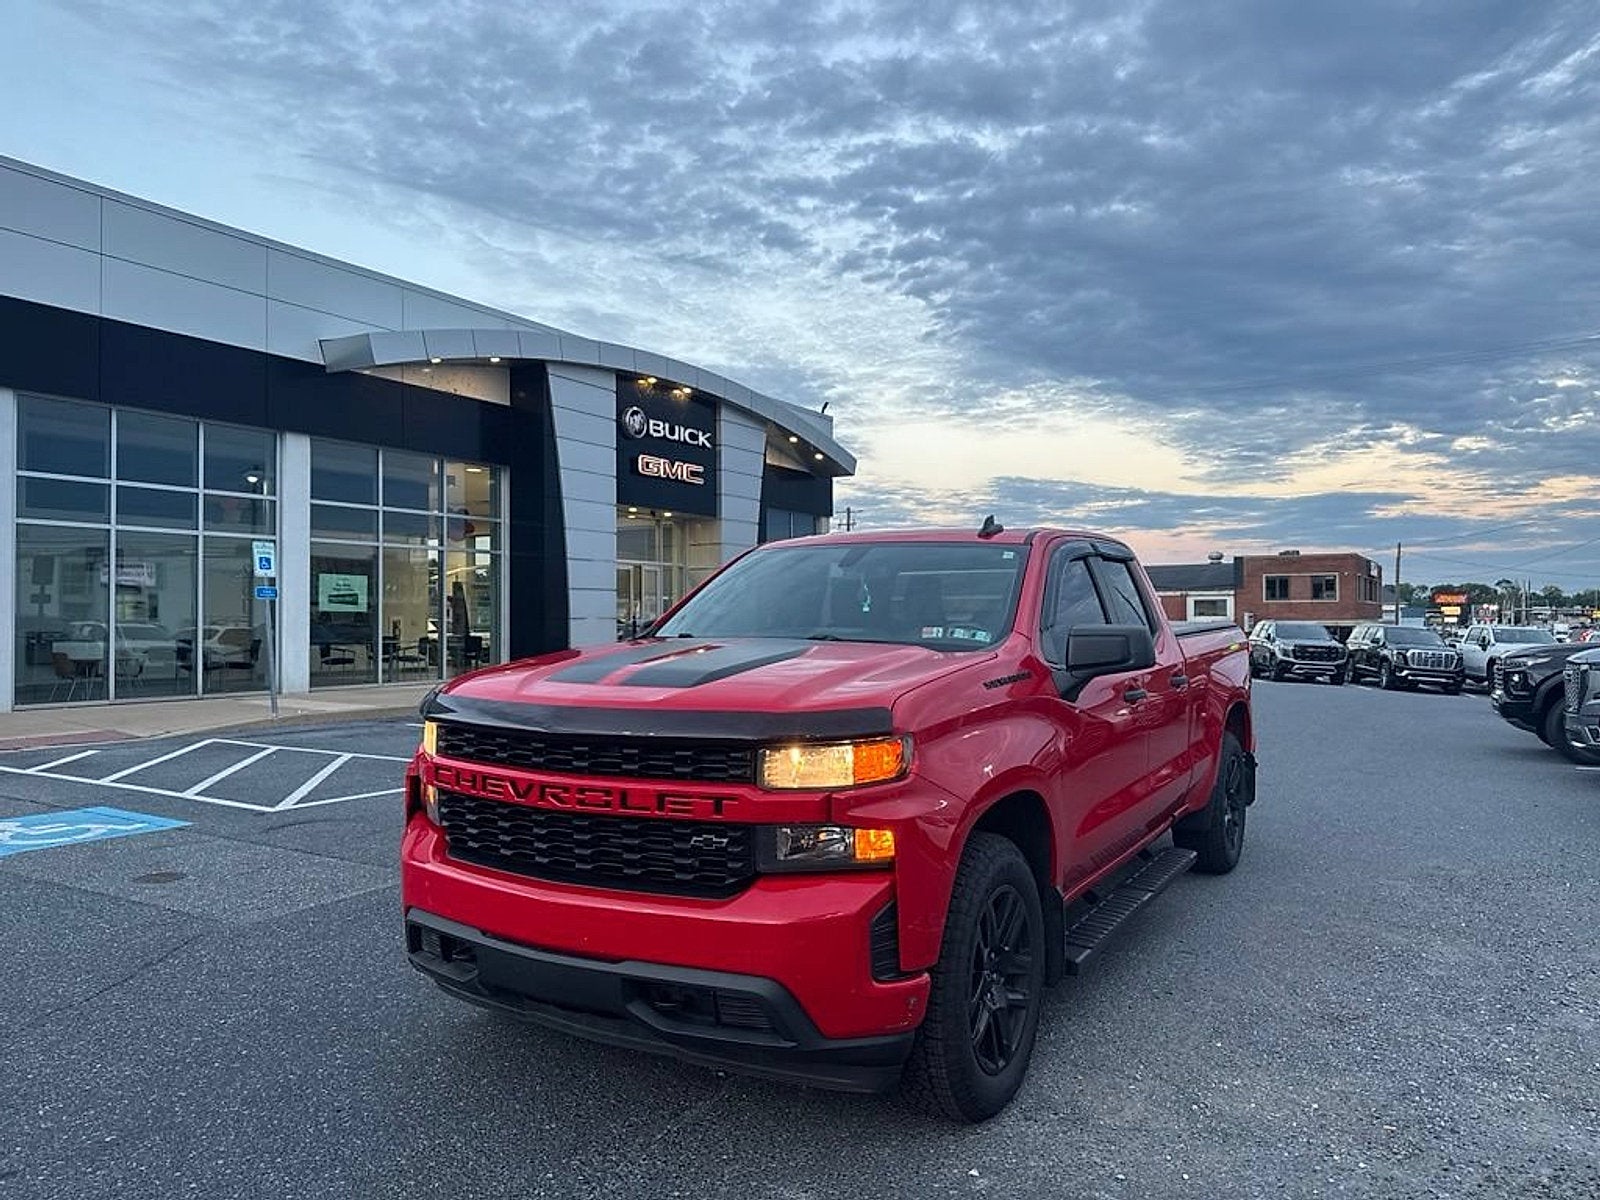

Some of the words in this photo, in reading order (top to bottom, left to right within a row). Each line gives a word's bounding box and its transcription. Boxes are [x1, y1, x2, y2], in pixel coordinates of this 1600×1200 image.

[649, 420, 712, 448] BUICK
[638, 455, 704, 484] GMC
[434, 767, 738, 818] CHEVROLET
